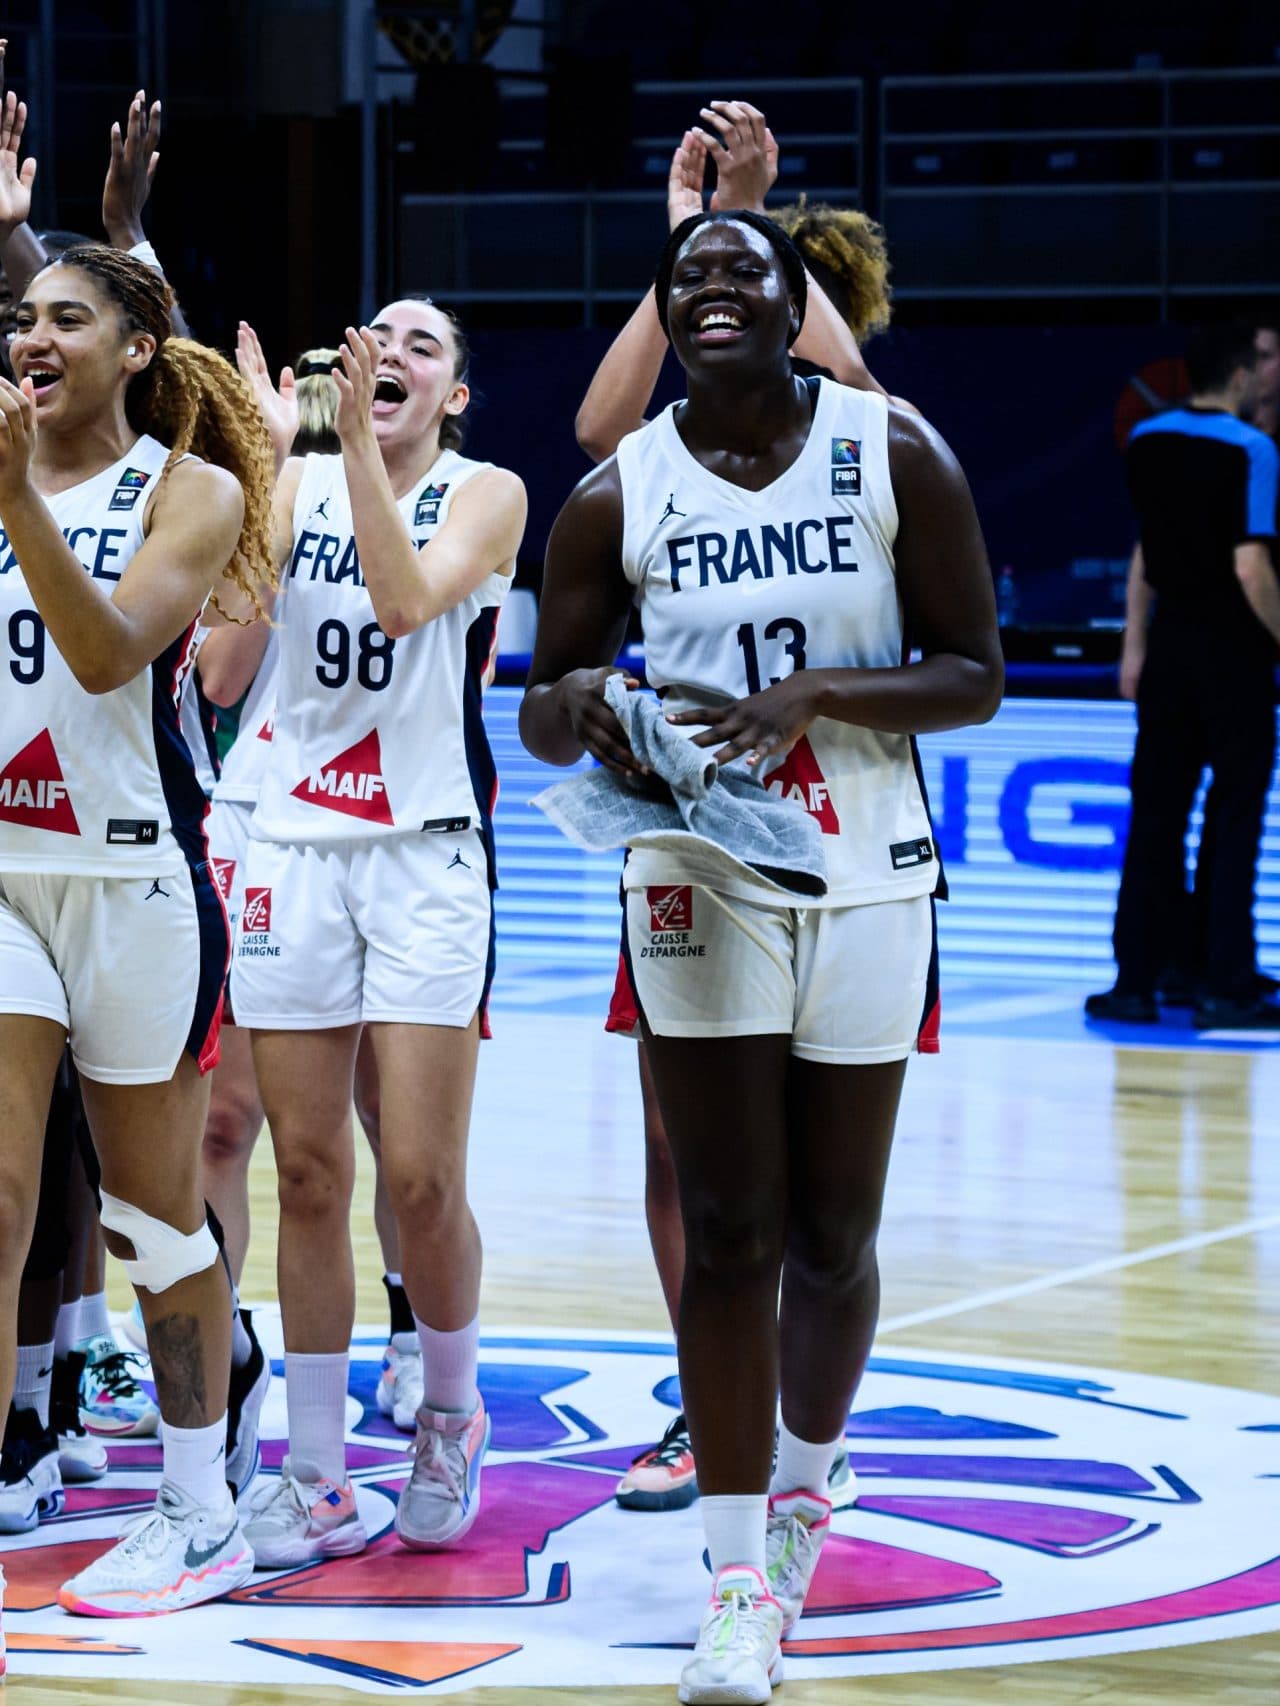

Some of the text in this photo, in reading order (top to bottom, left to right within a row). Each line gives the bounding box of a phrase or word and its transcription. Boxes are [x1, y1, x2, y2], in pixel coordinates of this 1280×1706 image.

[835, 470, 857, 481] FIBA
[667, 515, 859, 593] FRANCE
[8, 609, 46, 685] 9
[315, 618, 396, 692] 98
[737, 617, 807, 696] 13
[308, 769, 385, 801] MAIF
[142, 827, 152, 837] M
[919, 845, 931, 855] XL
[242, 934, 270, 945] CAISSE
[650, 932, 690, 945] CAISSE
[640, 945, 707, 958] D'EPARGNE
